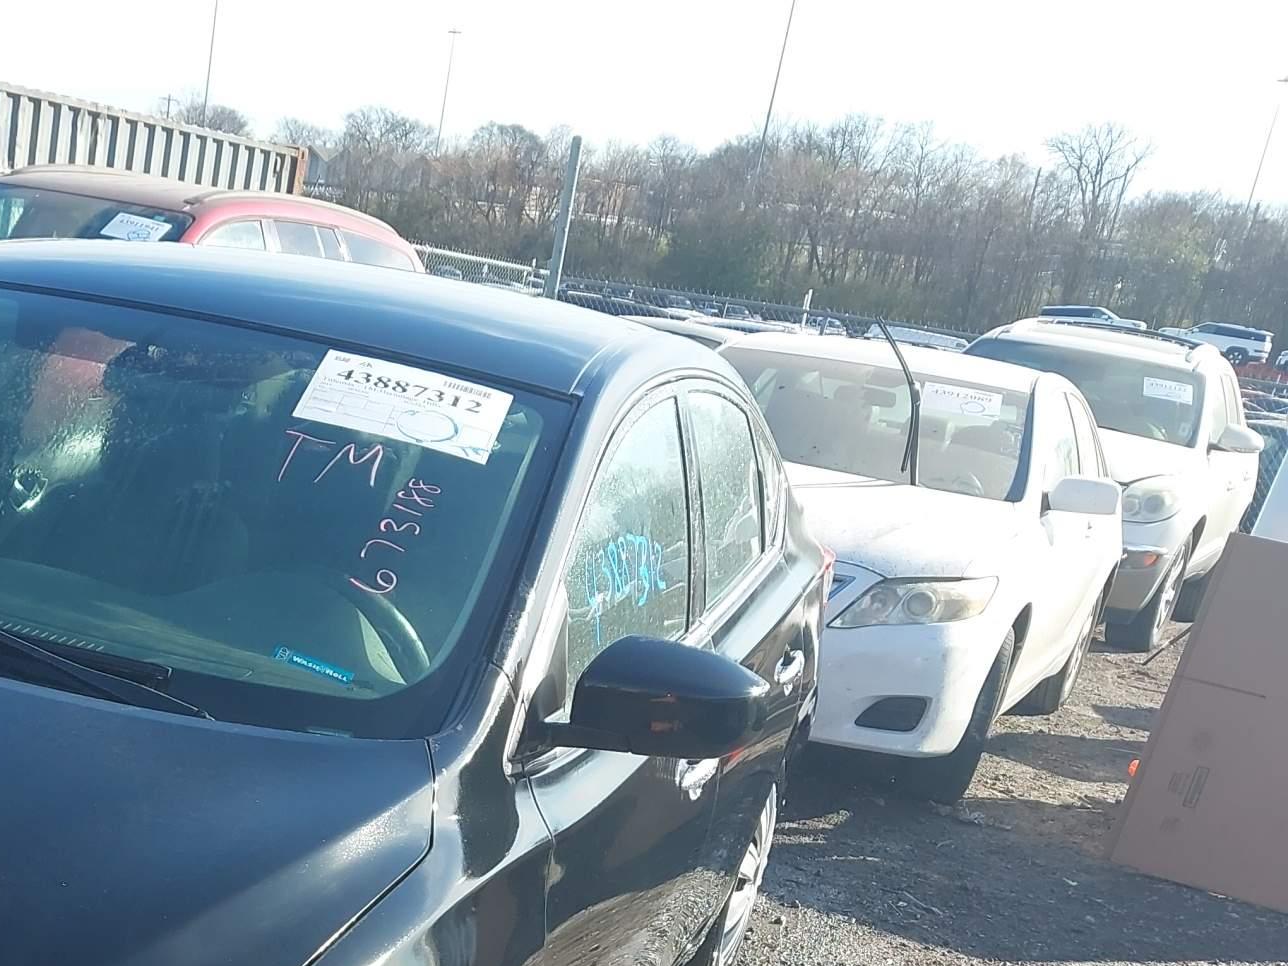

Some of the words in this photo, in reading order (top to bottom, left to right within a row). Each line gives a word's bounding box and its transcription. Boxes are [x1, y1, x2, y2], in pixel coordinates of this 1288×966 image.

[337, 368, 485, 414] 43887312
[278, 429, 384, 488] TM
[349, 477, 442, 594] 673188
